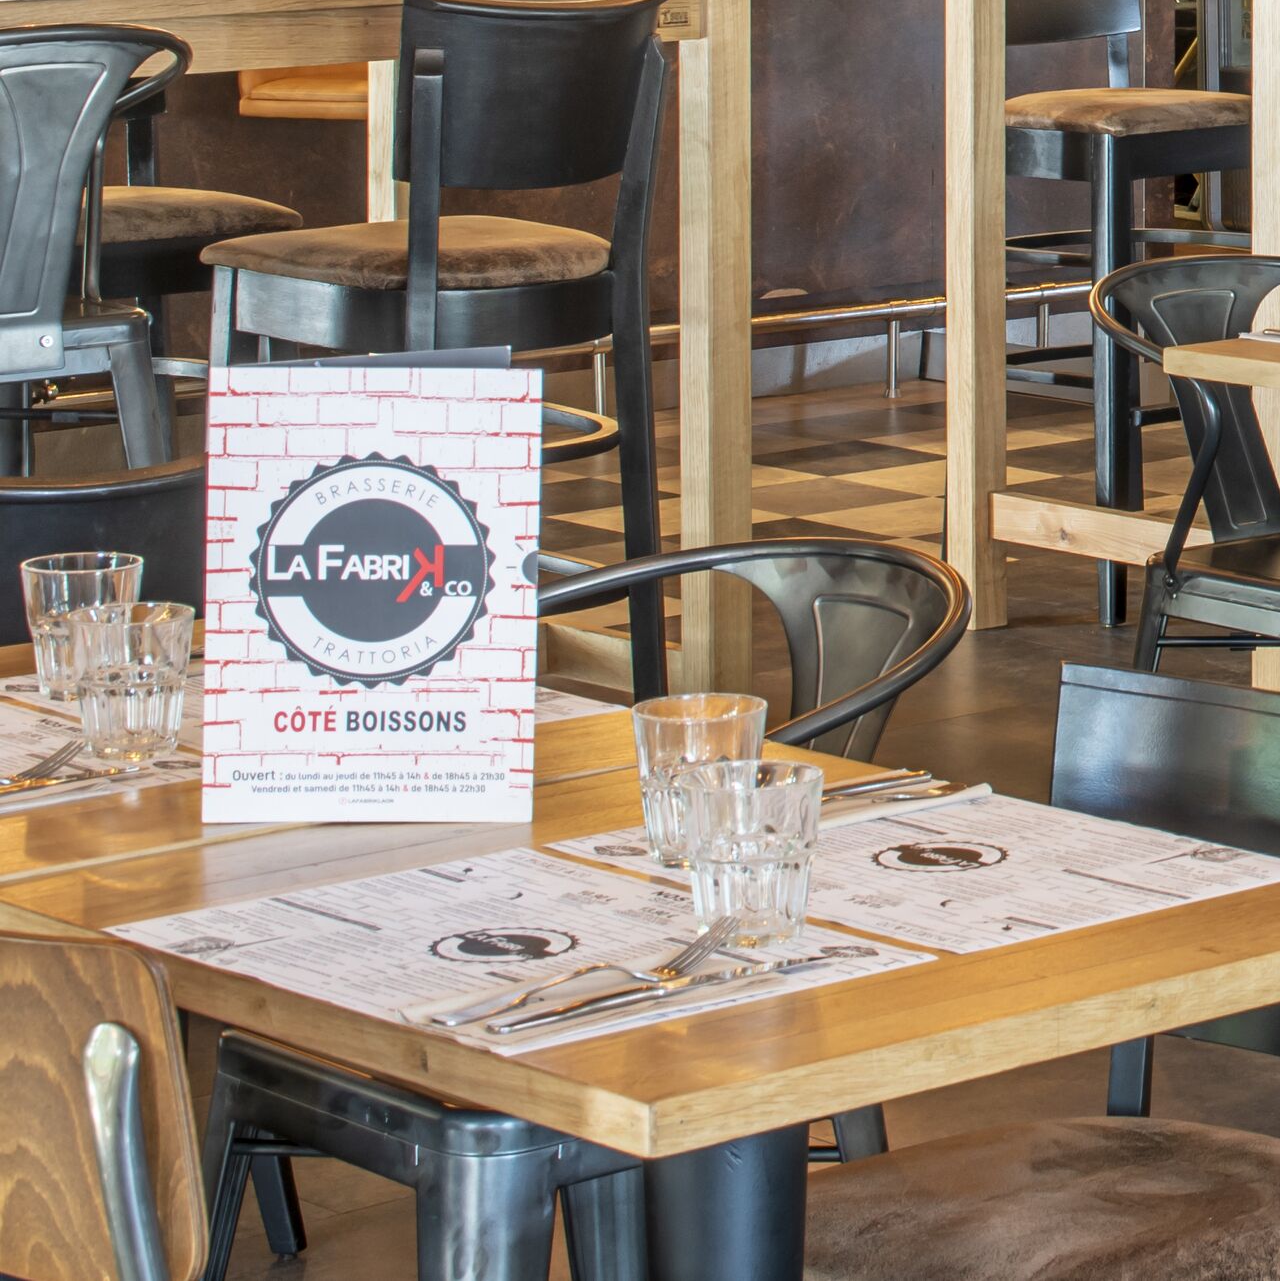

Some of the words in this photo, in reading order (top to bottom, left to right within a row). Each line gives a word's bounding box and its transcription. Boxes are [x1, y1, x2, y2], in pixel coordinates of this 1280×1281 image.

[314, 477, 440, 510] BRASSERIE
[266, 544, 312, 581] LA
[317, 544, 445, 604] FABRIK
[419, 580, 433, 597] &
[444, 580, 473, 597] CO
[312, 635, 438, 665] TRATTORIA
[273, 705, 337, 733] CÔTÉ
[346, 710, 467, 734] BOISSONS
[232, 769, 276, 782] Ouvert
[285, 772, 297, 781] du
[297, 772, 321, 781] lundi
[322, 772, 334, 781] au
[335, 772, 358, 782] jeudi
[359, 772, 371, 780] de
[372, 772, 396, 781] 11h45
[406, 772, 421, 781] 14h
[431, 772, 443, 781] de
[445, 772, 471, 781] 18h45
[480, 772, 505, 781] 21h30
[251, 784, 291, 794] Vendredi
[292, 784, 302, 794] et
[304, 784, 337, 794] samedi
[338, 784, 350, 794] de
[352, 784, 376, 794] 11h45
[385, 784, 401, 794] 14h
[411, 784, 422, 794] de
[424, 784, 450, 794] 18h45
[459, 784, 486, 794] 22h30
